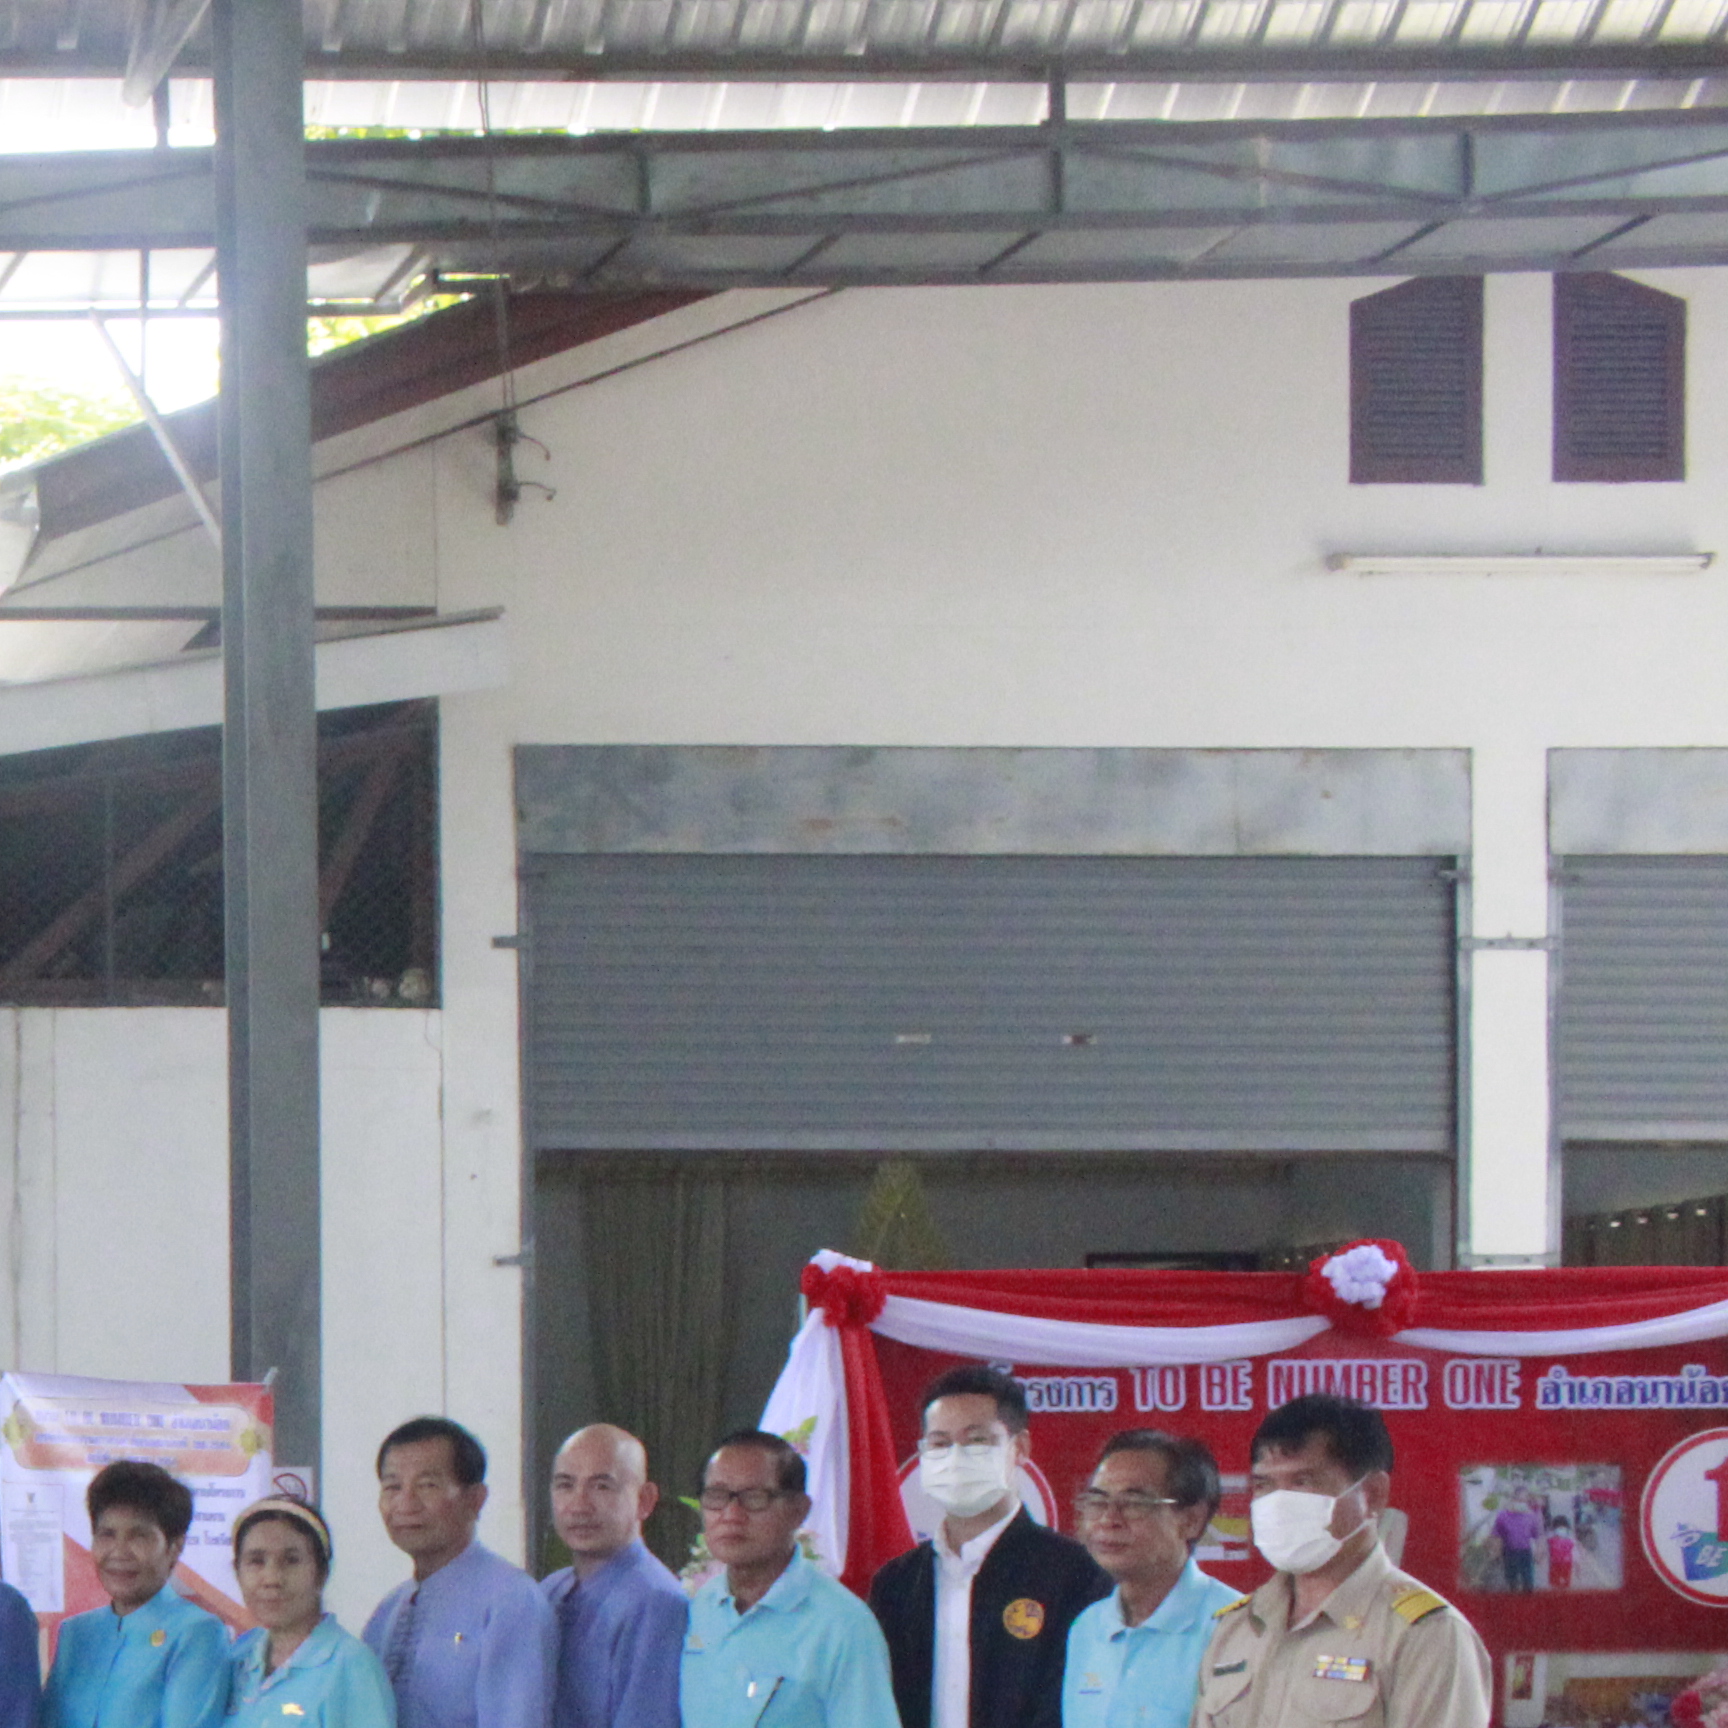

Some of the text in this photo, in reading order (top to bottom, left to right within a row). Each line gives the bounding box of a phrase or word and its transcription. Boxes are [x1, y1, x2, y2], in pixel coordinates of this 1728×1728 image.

[1131, 1364, 1185, 1410] TO
[1201, 1361, 1252, 1410] BE
[1444, 1359, 1521, 1409] ONE
